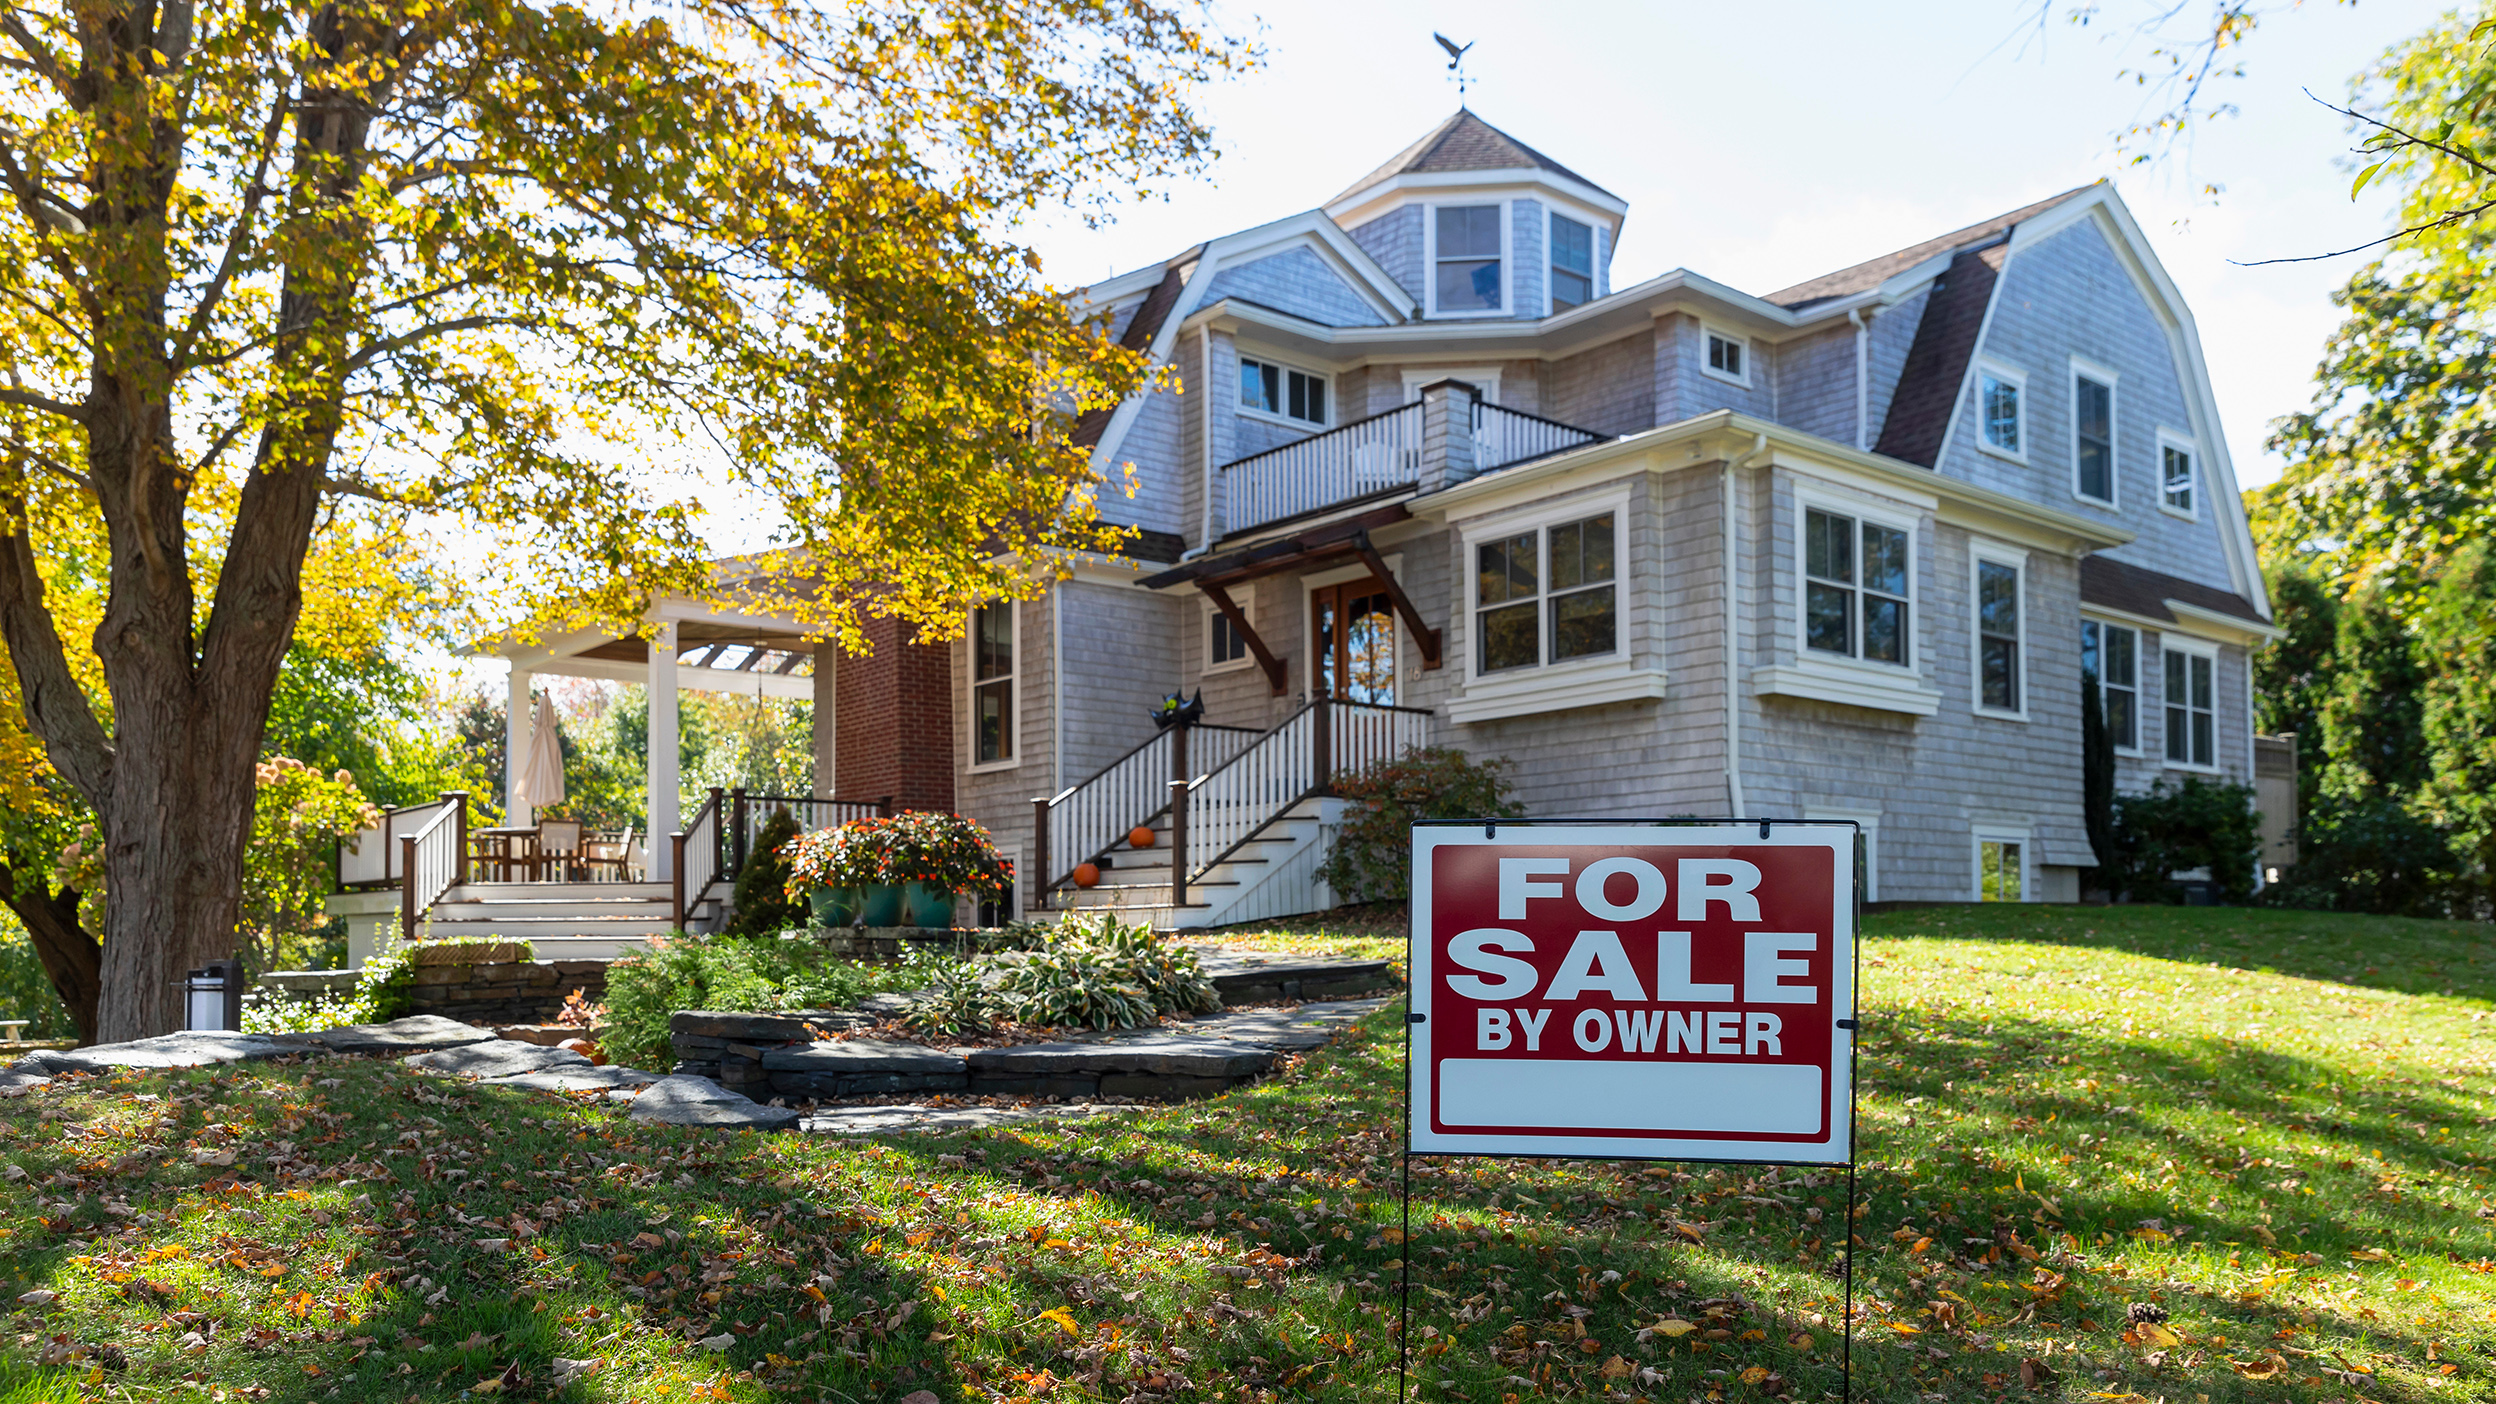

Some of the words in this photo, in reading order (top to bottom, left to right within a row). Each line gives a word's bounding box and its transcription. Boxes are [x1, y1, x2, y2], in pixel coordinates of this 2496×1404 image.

[1498, 856, 1763, 922] FOR
[1445, 928, 1818, 1004] SALE
[1477, 1008, 1552, 1051] BY
[1573, 1008, 1783, 1056] OWNER
